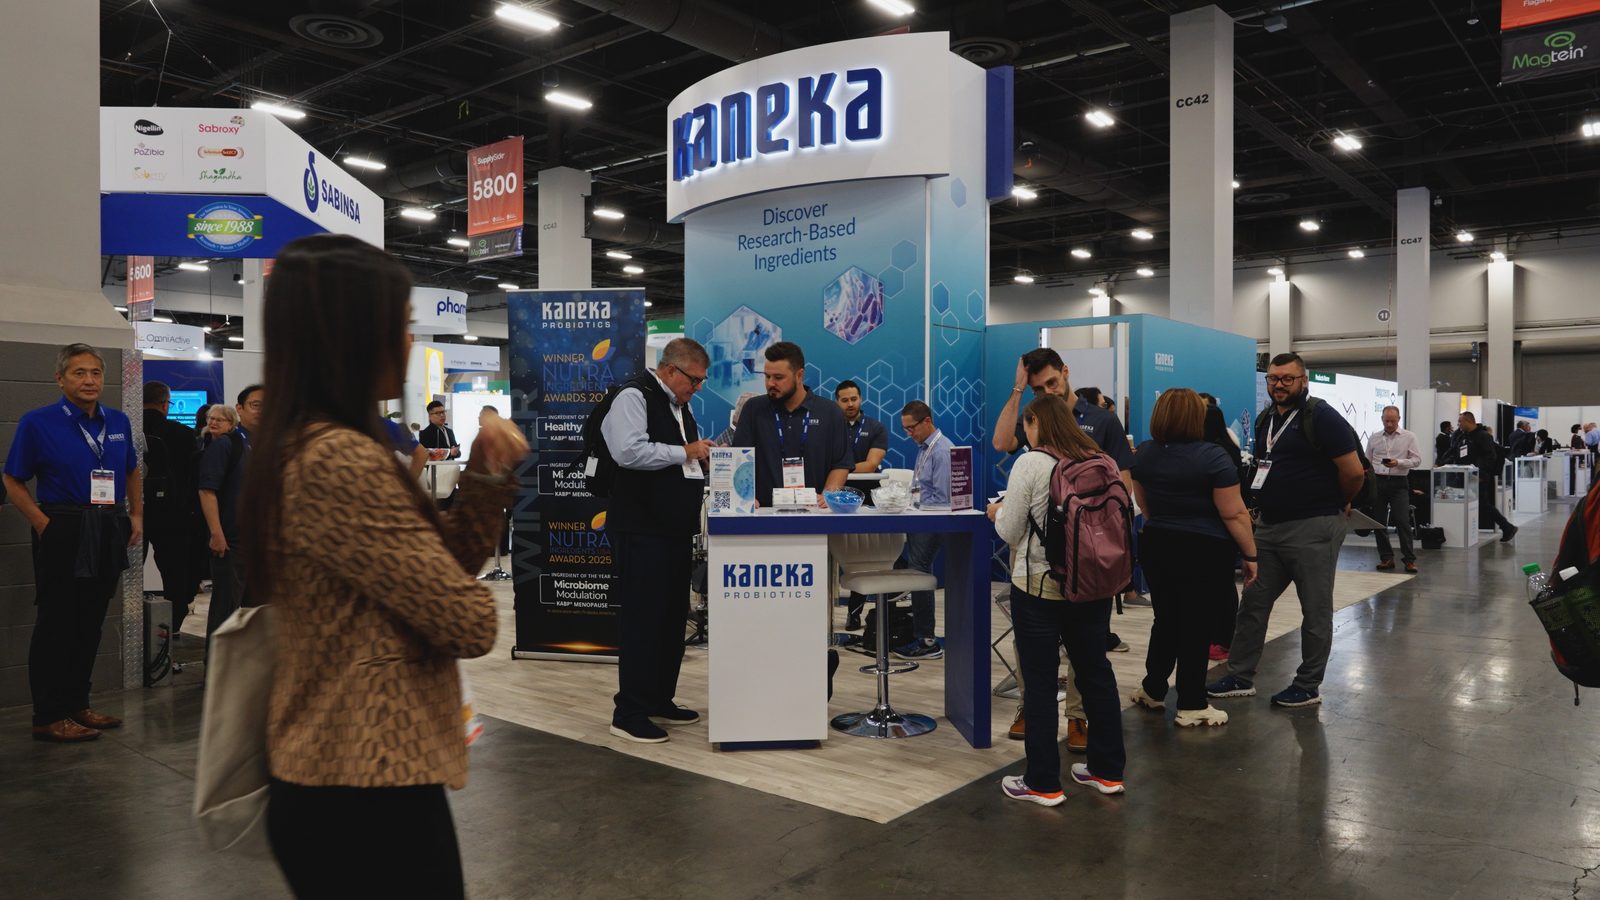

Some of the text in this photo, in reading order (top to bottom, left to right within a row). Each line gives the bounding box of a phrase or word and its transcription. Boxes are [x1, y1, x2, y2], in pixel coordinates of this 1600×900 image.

[1176, 94, 1209, 108] CC42
[135, 124, 162, 133] Nigellin
[198, 123, 240, 135] Sabroxy
[473, 172, 517, 201] 5800
[321, 178, 361, 224] SABINSA
[763, 202, 829, 226] Discover
[194, 220, 255, 234] since 1988
[738, 218, 857, 251] Research-Based
[1400, 236, 1423, 245] CC47
[753, 245, 838, 272] Ingredients
[129, 264, 152, 281] 5600
[542, 321, 611, 329] PROBIOTICS
[146, 333, 191, 345] OmniActive
[543, 353, 585, 362] WINNER
[543, 363, 615, 381] NUTRA
[544, 393, 587, 403] AWARDS
[544, 422, 583, 433] Healthy
[548, 521, 586, 531] WINNER
[549, 531, 612, 548] NUTRA
[549, 554, 612, 564] AWARDS 2025
[554, 580, 609, 590] Microbiome
[556, 590, 607, 600] Modulation
[724, 591, 811, 599] PROBIOTICS
